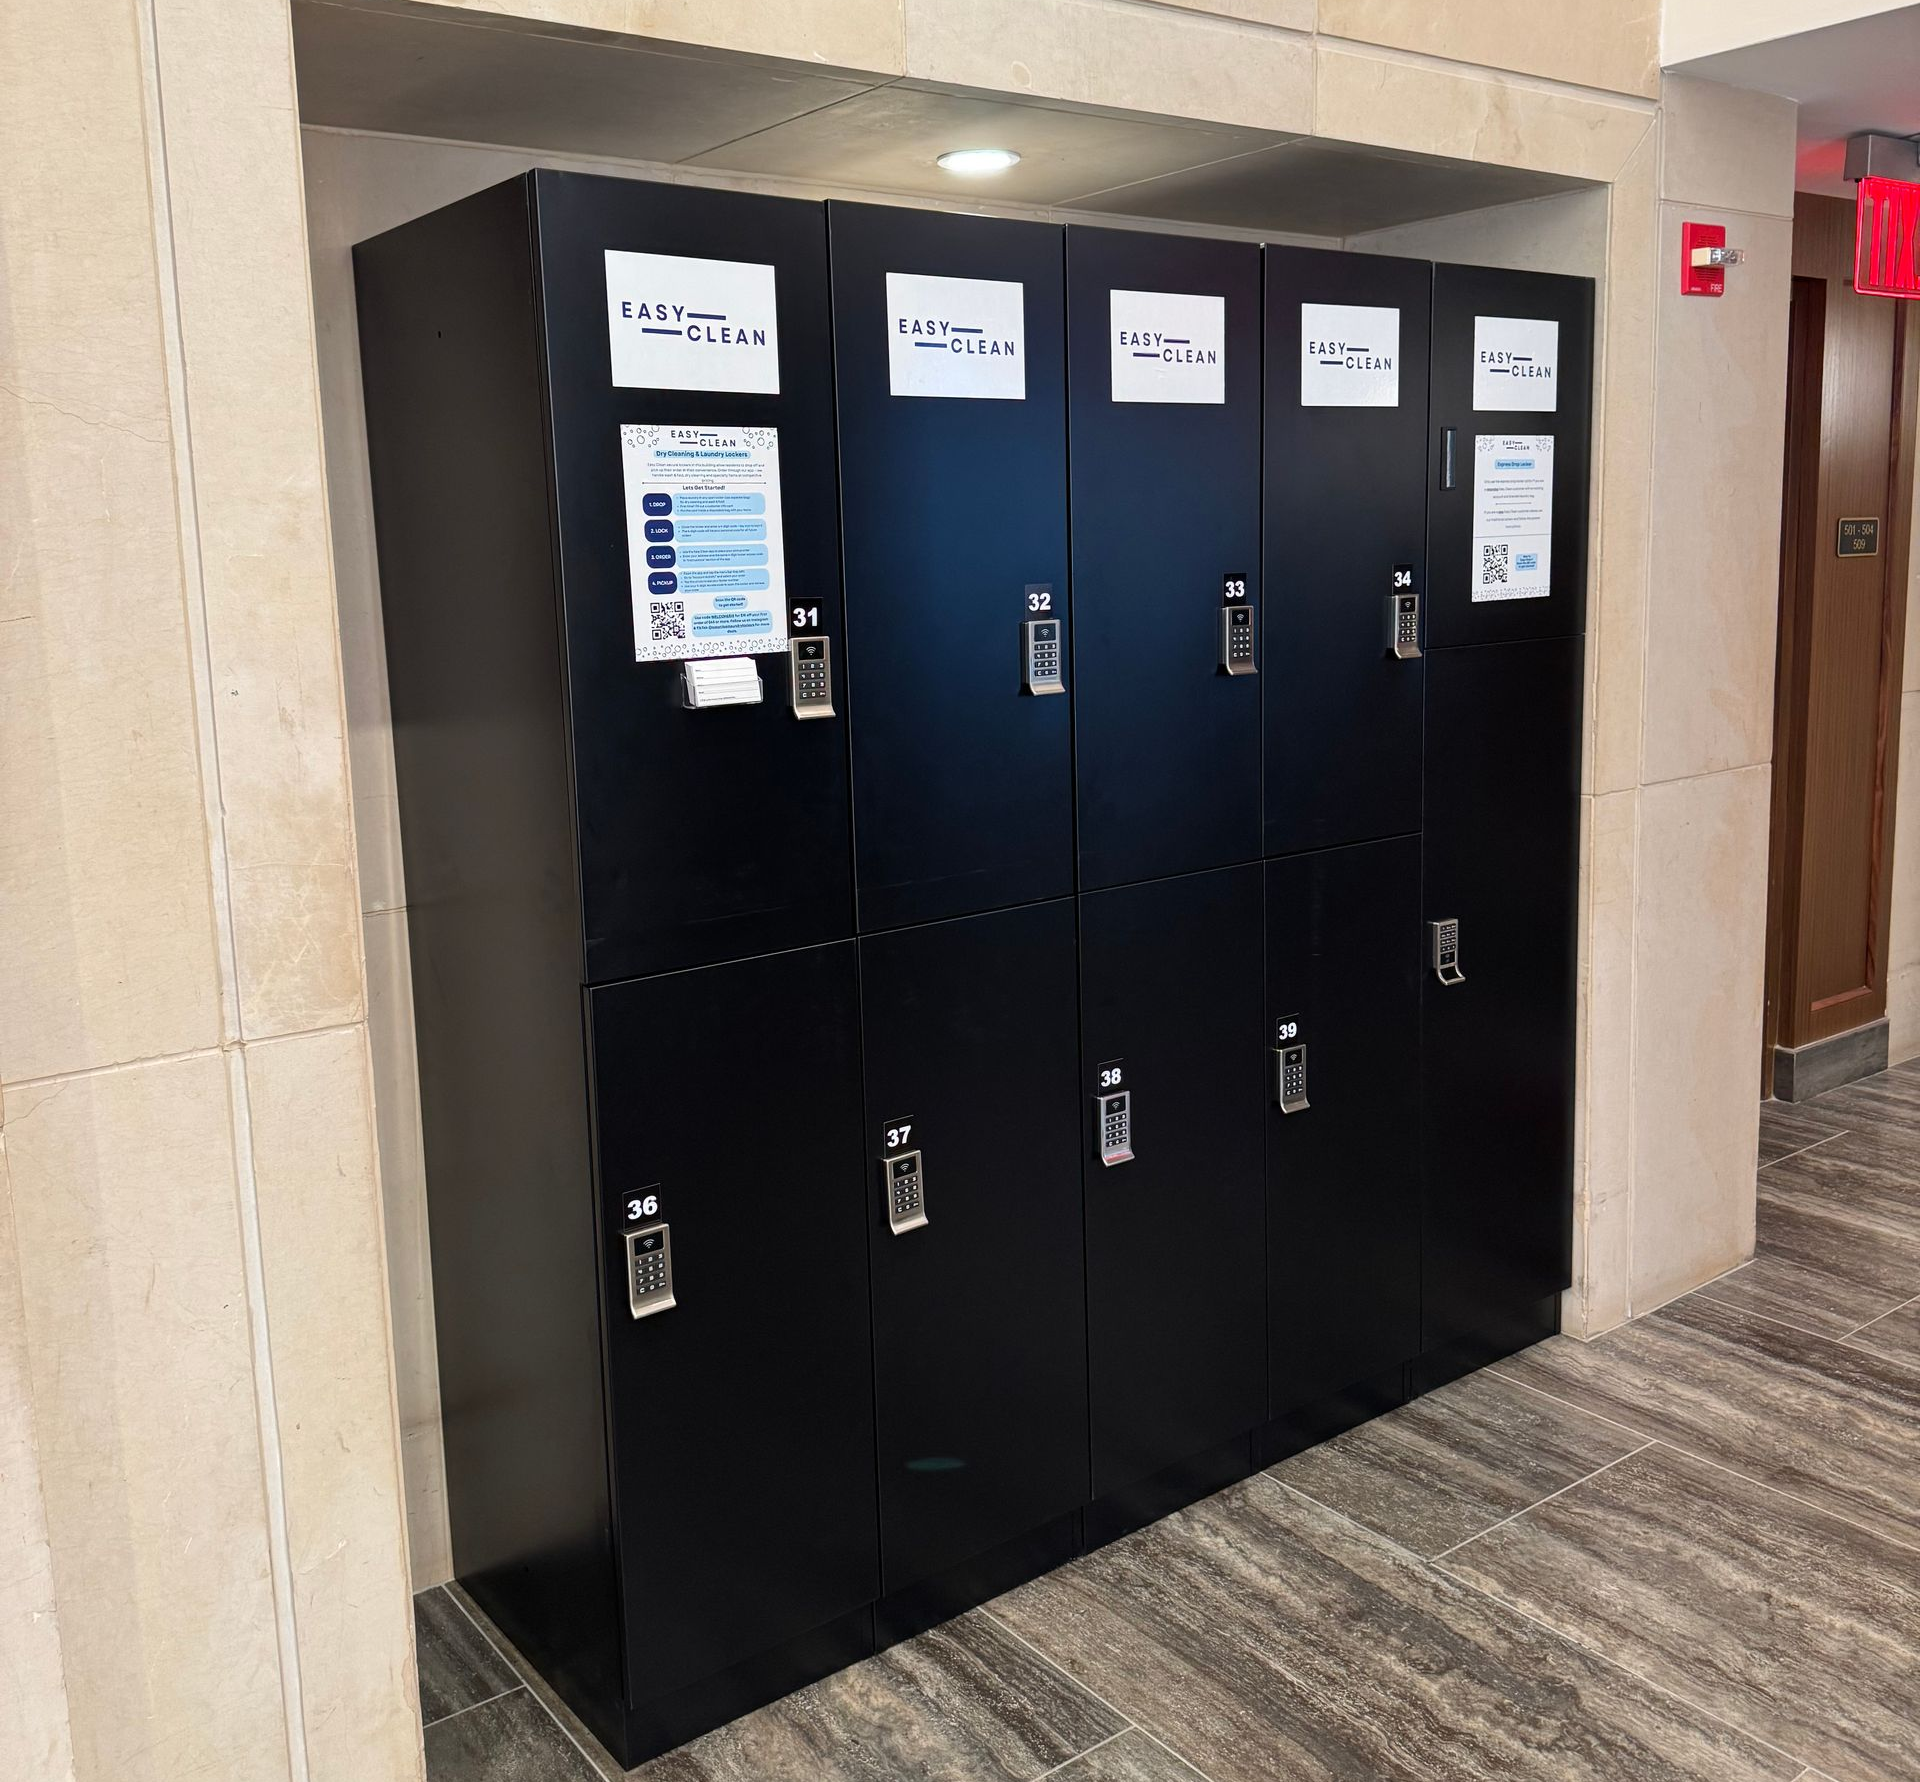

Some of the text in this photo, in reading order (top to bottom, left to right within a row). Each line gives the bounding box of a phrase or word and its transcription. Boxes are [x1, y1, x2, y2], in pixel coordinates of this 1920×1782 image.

[622, 301, 685, 322] EASY
[686, 324, 766, 346] CLEAN
[898, 318, 950, 336] EASY
[951, 338, 1014, 356] CLEAN
[1120, 332, 1162, 346] EASY
[1310, 341, 1346, 355] EASY
[1163, 348, 1216, 364] CLEAN
[1346, 356, 1391, 370] CLEAN
[1481, 351, 1512, 364] EASY
[1512, 365, 1551, 378] CLEAN
[670, 430, 699, 438] EASY
[700, 438, 736, 447] CLEAN
[1844, 524, 1856, 536] 501
[1862, 524, 1874, 535] 504
[1853, 538, 1866, 550] 509
[1394, 570, 1412, 588] 34
[1225, 580, 1245, 598] 33
[1028, 592, 1051, 612] 32
[792, 607, 818, 627] 31
[1279, 1022, 1297, 1040] 39
[1100, 1067, 1122, 1087] 38
[887, 1124, 912, 1148] 37
[627, 1195, 658, 1220] 36
